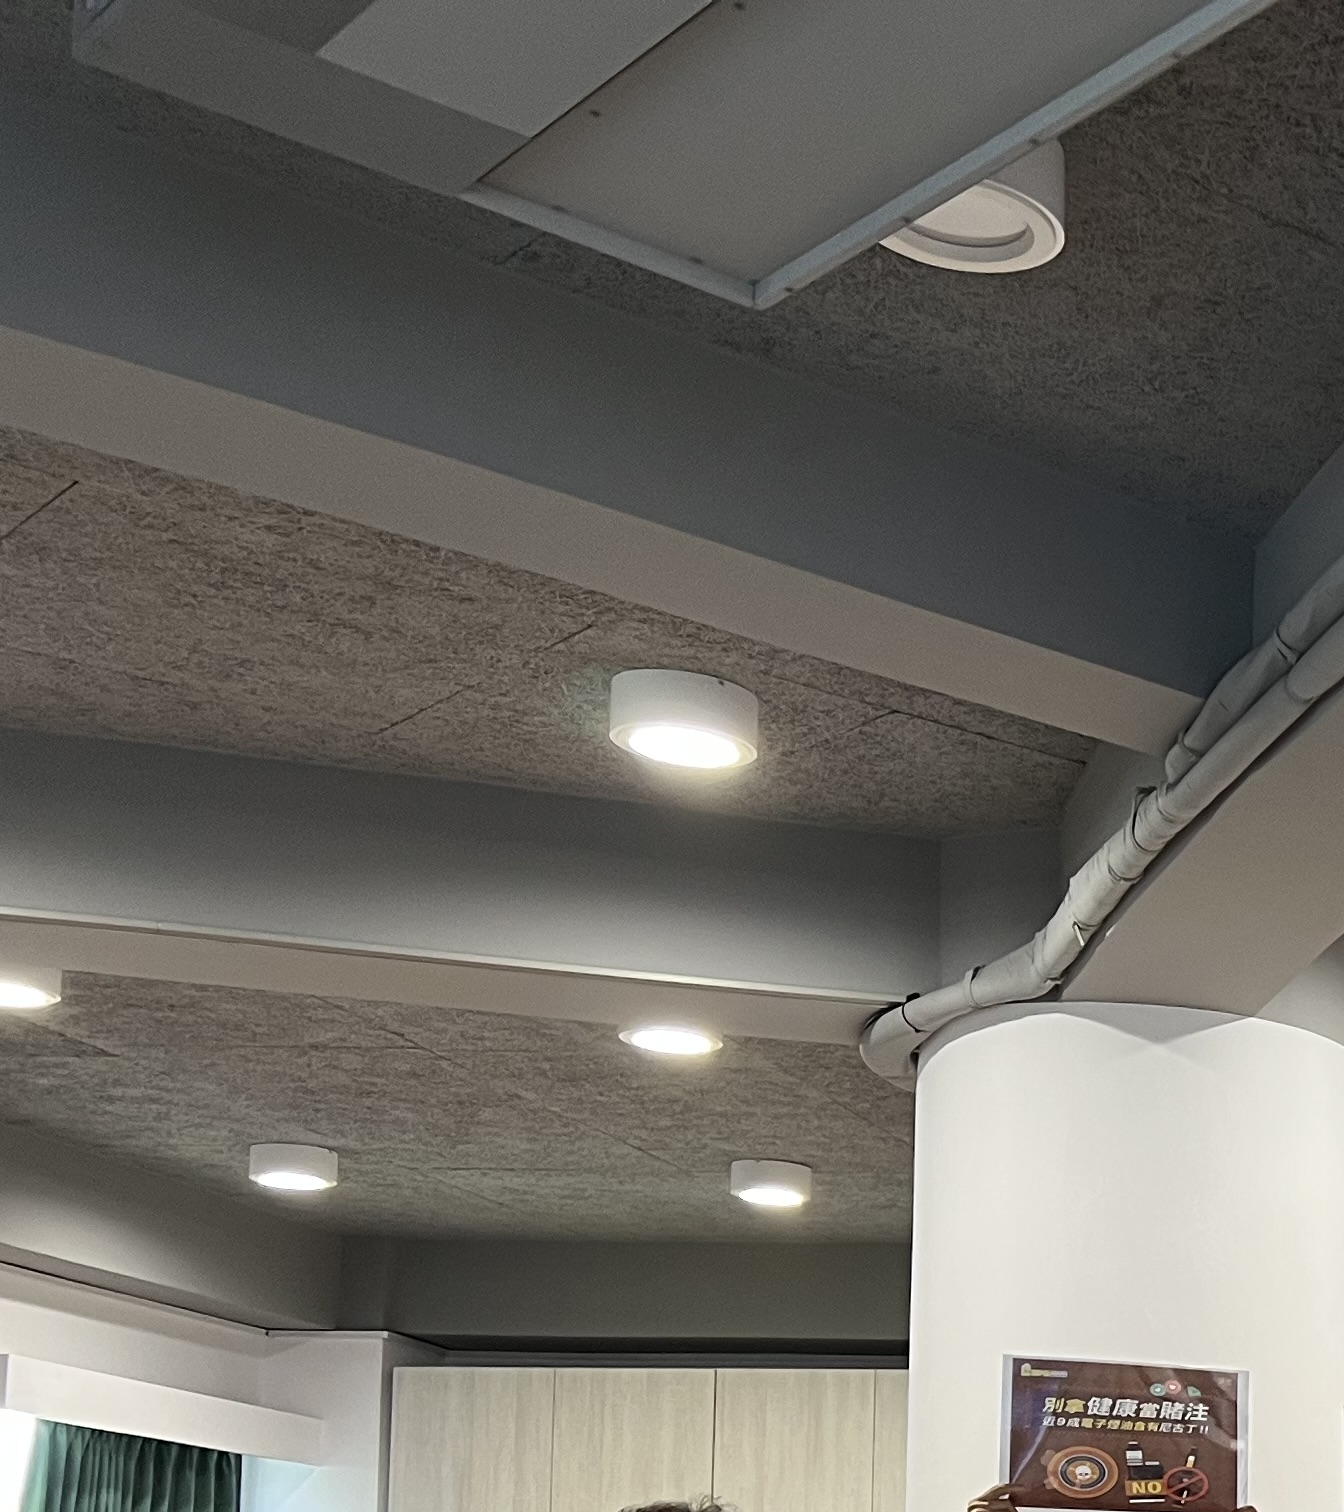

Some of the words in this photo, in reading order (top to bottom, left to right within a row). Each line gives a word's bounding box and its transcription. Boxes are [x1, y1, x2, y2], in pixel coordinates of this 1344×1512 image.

[1042, 1397, 1209, 1421] 別拿健康當賭注
[1132, 1482, 1162, 1494] NO
